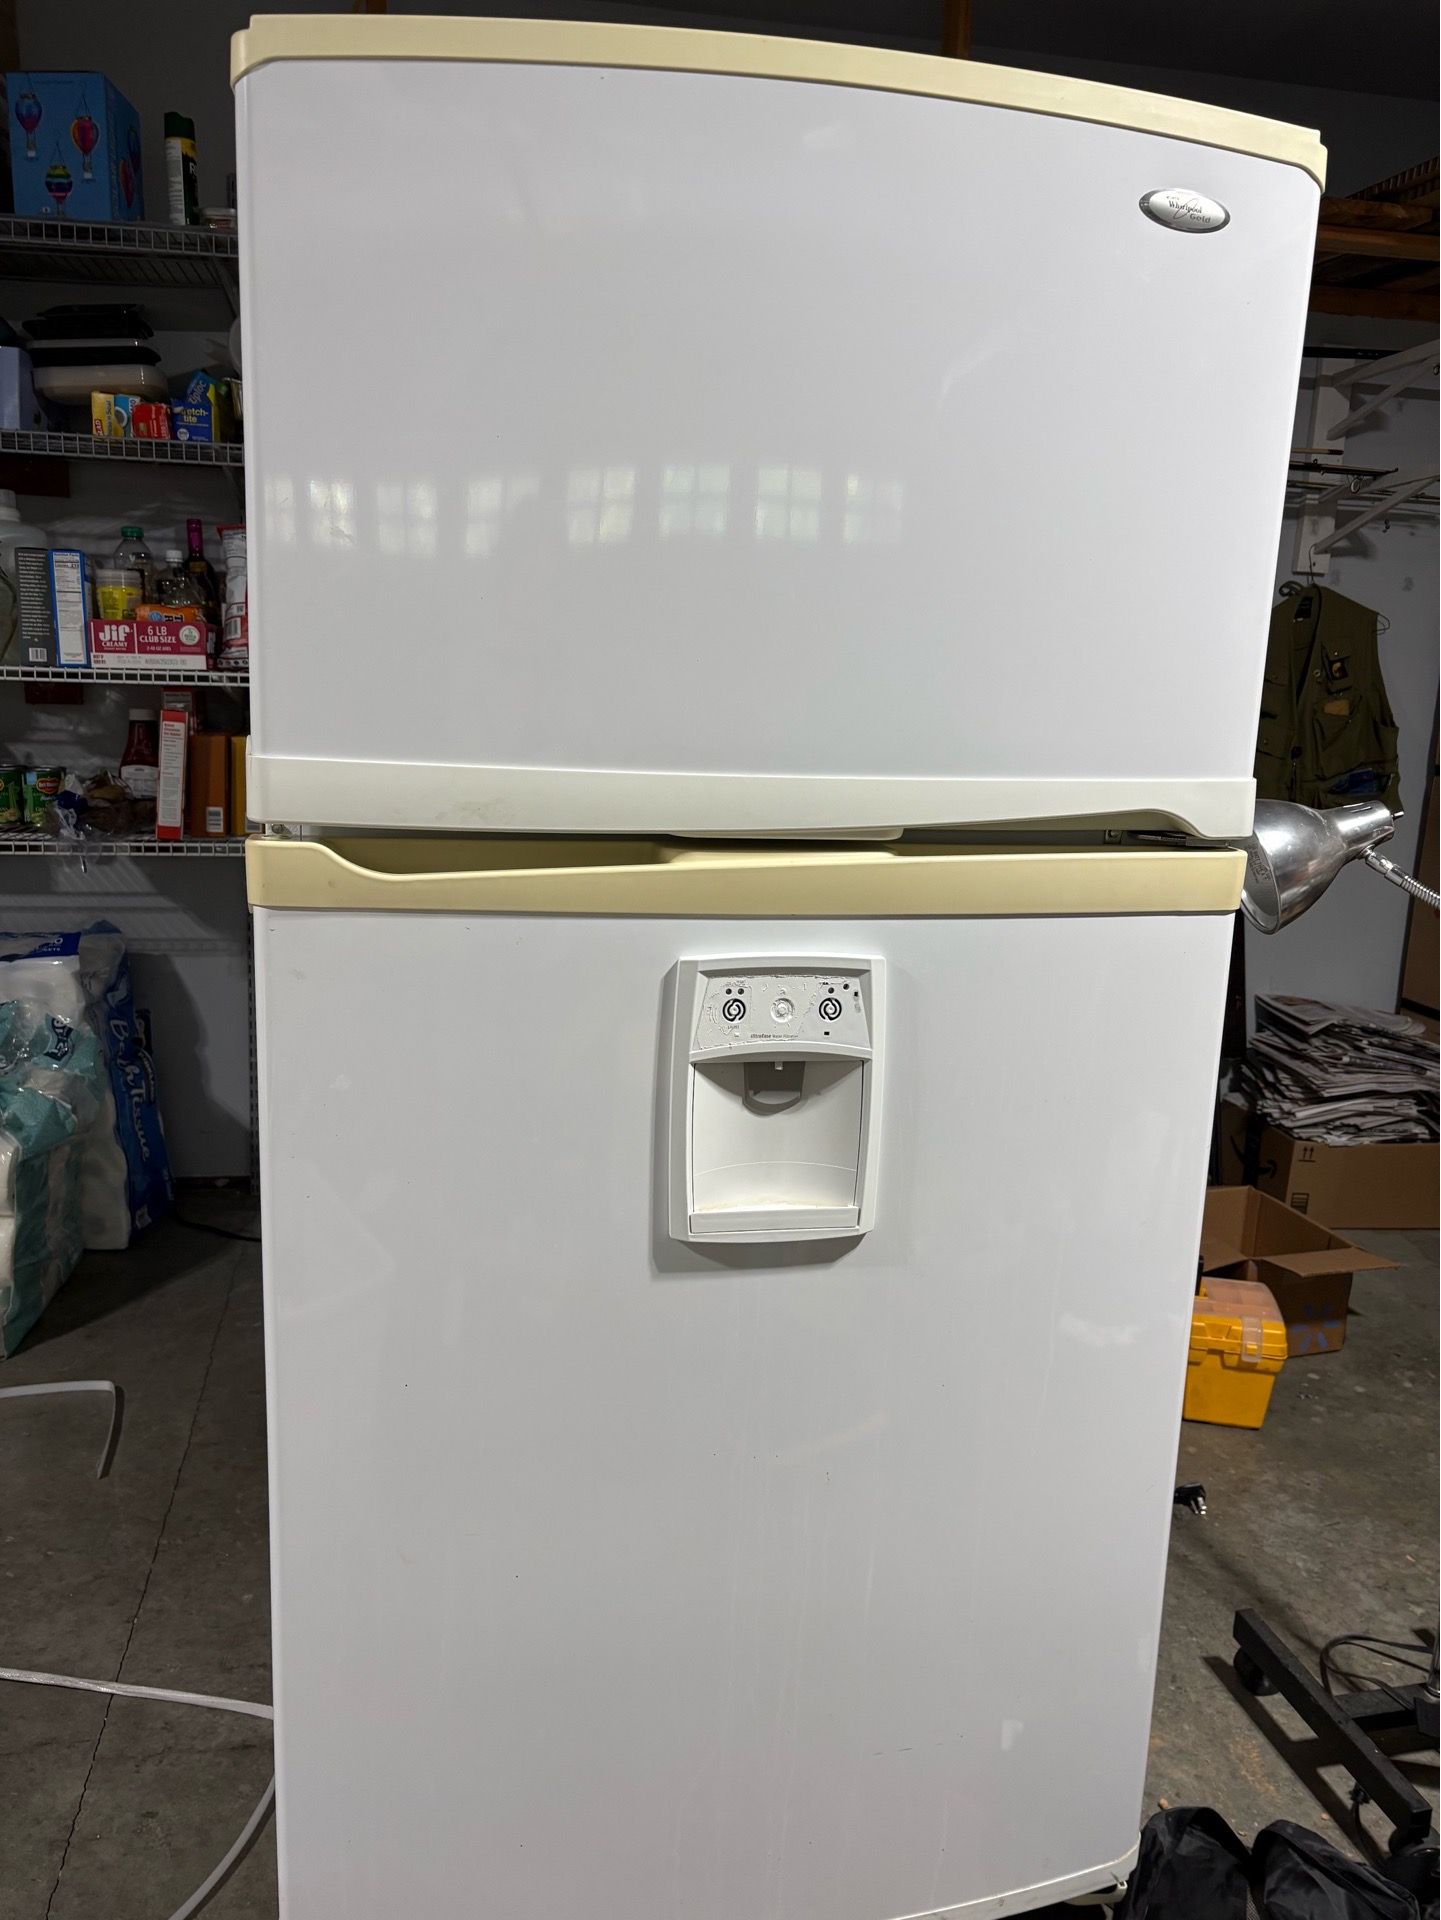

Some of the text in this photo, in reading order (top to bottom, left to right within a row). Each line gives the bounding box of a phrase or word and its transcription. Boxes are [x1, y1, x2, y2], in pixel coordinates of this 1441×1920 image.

[1168, 200, 1202, 213] Whirlpool
[1189, 213, 1211, 224] Gold
[98, 624, 130, 642] Jif
[147, 625, 168, 636] 6 LB
[139, 635, 159, 643] CLUB
[129, 1080, 153, 1163] Tissue
